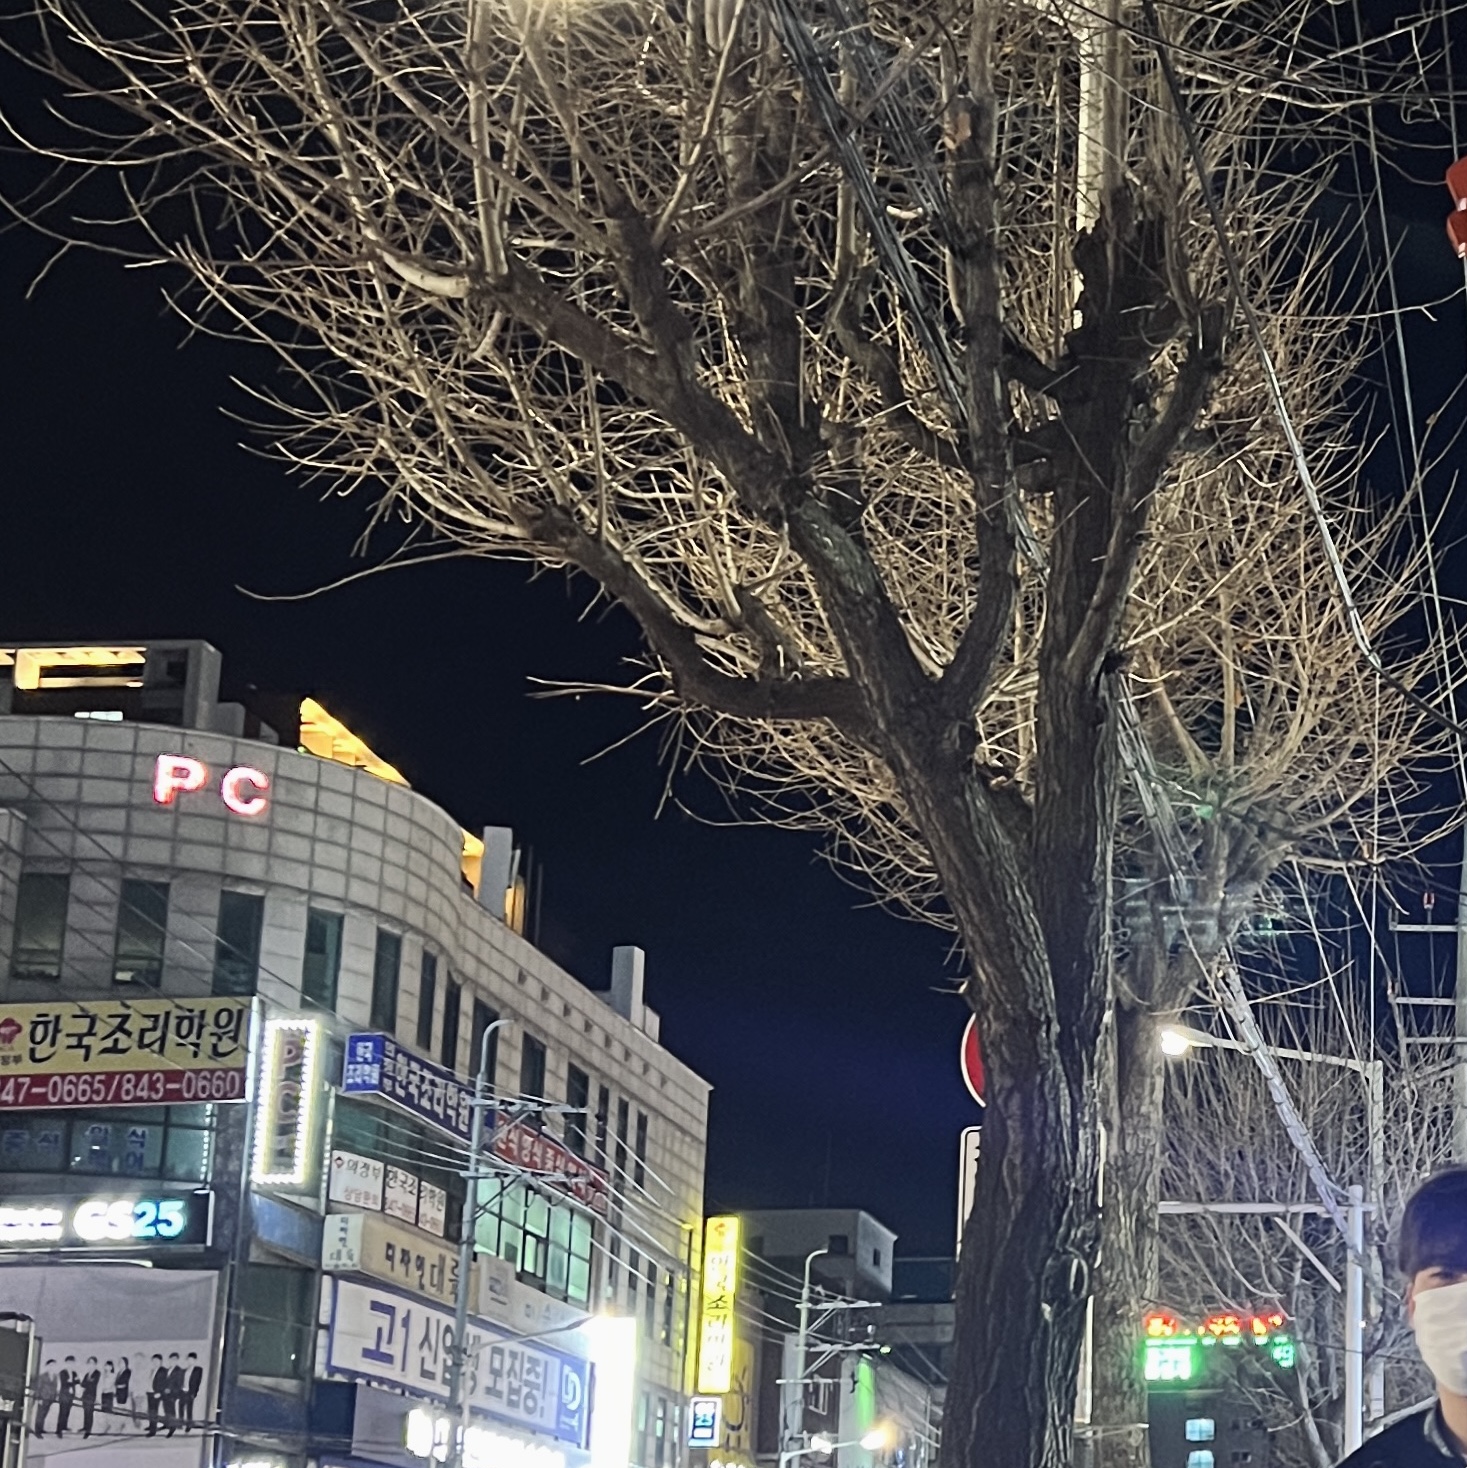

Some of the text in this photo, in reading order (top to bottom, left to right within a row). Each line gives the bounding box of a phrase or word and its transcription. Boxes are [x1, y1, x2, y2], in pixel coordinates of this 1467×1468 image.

[153, 753, 270, 816] PC
[29, 1007, 244, 1064] 한국조리학원
[395, 1052, 470, 1133] 한국조리학원
[73, 1200, 186, 1241] GS25
[361, 1300, 412, 1373] 고1
[484, 1345, 549, 1419] 모집중!
